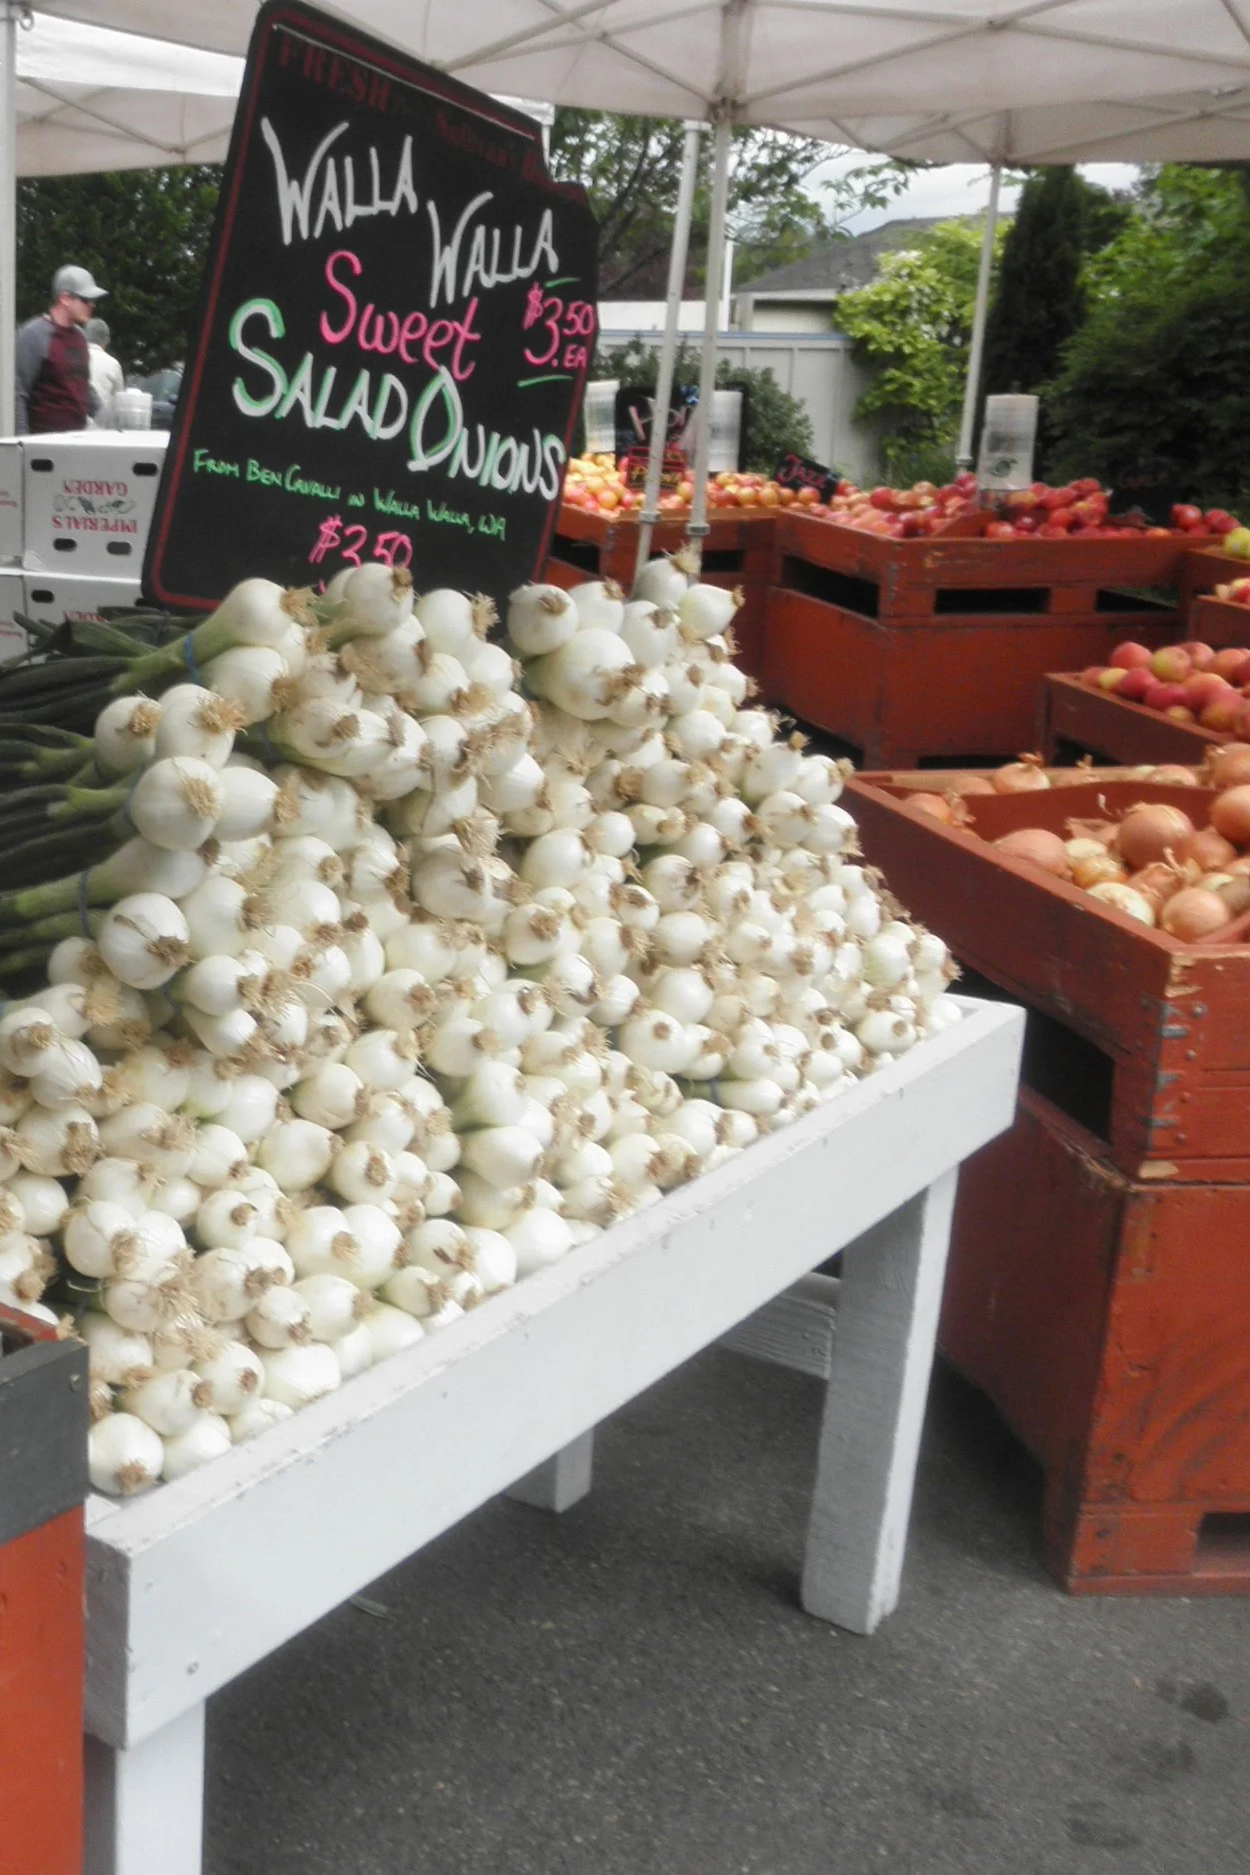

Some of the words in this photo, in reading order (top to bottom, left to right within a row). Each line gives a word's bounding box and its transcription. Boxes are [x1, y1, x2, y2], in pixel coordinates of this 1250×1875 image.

[260, 116, 419, 246] WALLA
[427, 190, 559, 309] WALLA
[320, 250, 481, 380] Sweet
[229, 298, 409, 440] SALAD
[406, 365, 567, 501] ONIONS
[62, 479, 129, 498] GARDEN
